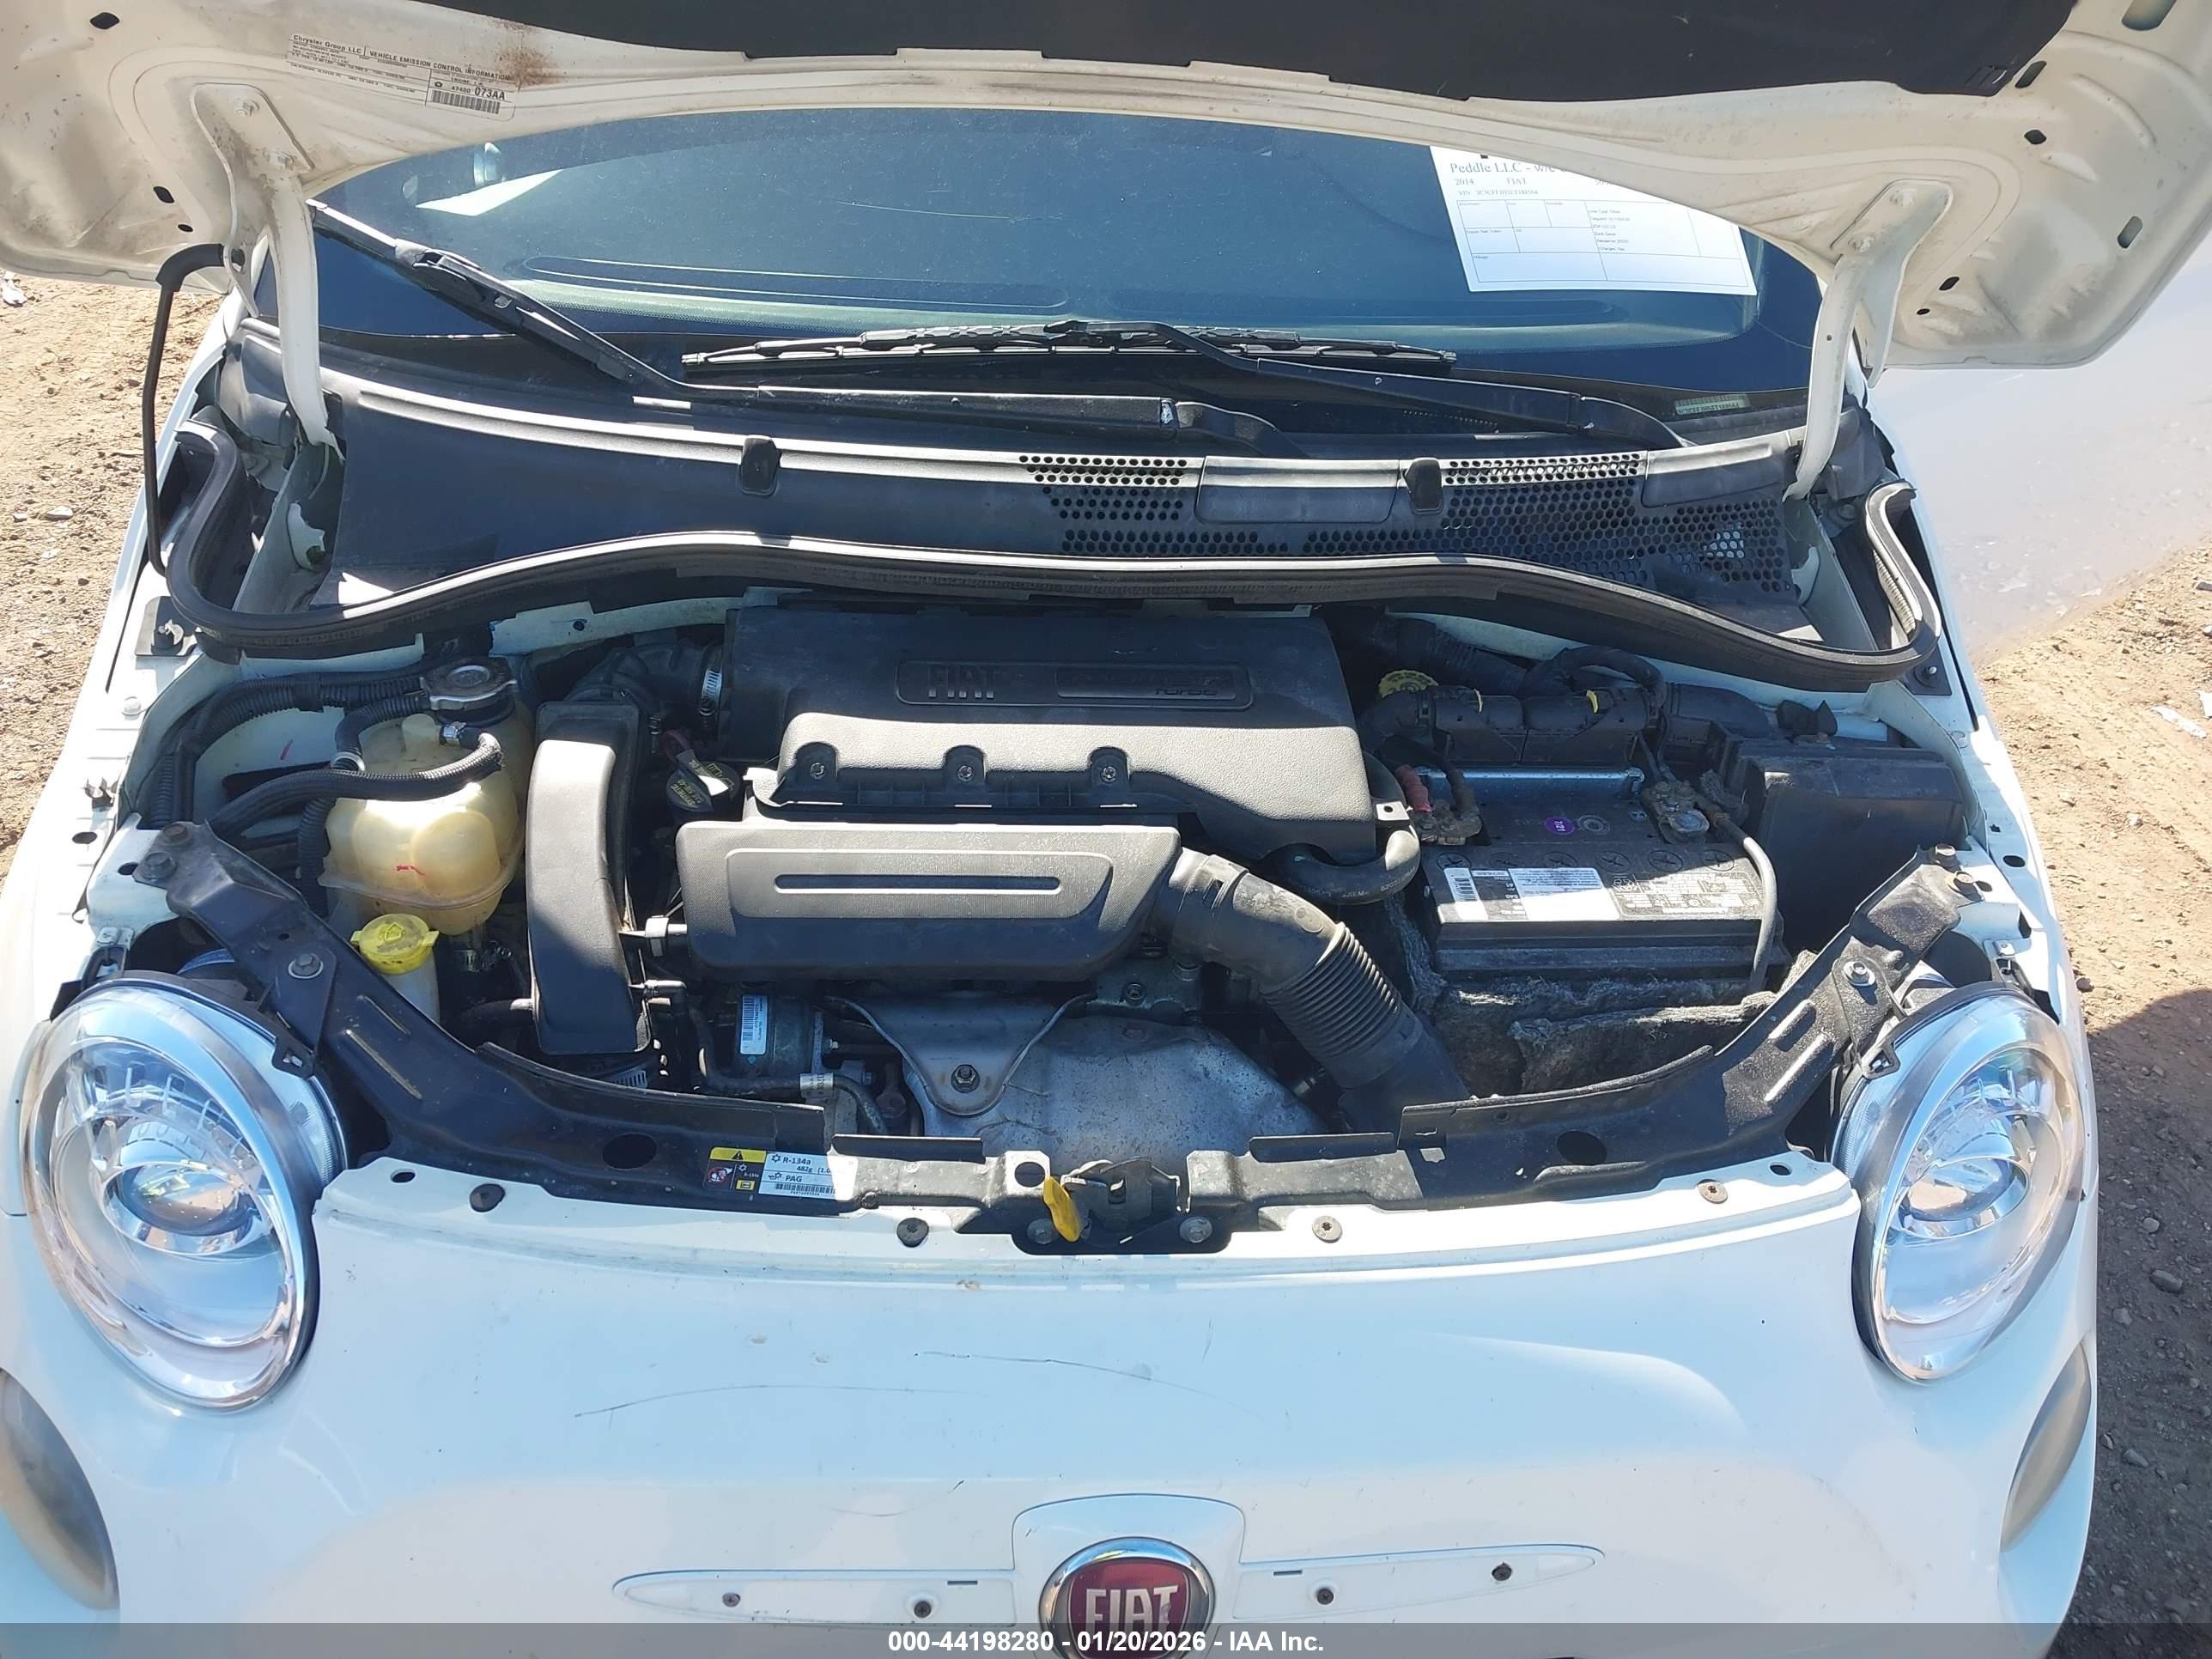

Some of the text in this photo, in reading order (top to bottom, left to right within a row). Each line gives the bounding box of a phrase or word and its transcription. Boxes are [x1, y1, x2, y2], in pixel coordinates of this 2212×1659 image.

[293, 33, 362, 55] Chrysler Group LLC
[369, 50, 397, 61] VEHICLE
[399, 56, 431, 68] EMISSION
[433, 62, 463, 73] CONTROL
[465, 68, 511, 81] INFORMATION
[474, 87, 505, 100] 073AA
[1449, 162, 1492, 173] Peddle
[1495, 162, 1522, 173] LLC
[782, 1156, 812, 1165] R-134a
[785, 1174, 803, 1183] PAG
[1085, 1584, 1179, 1644] FIAT
